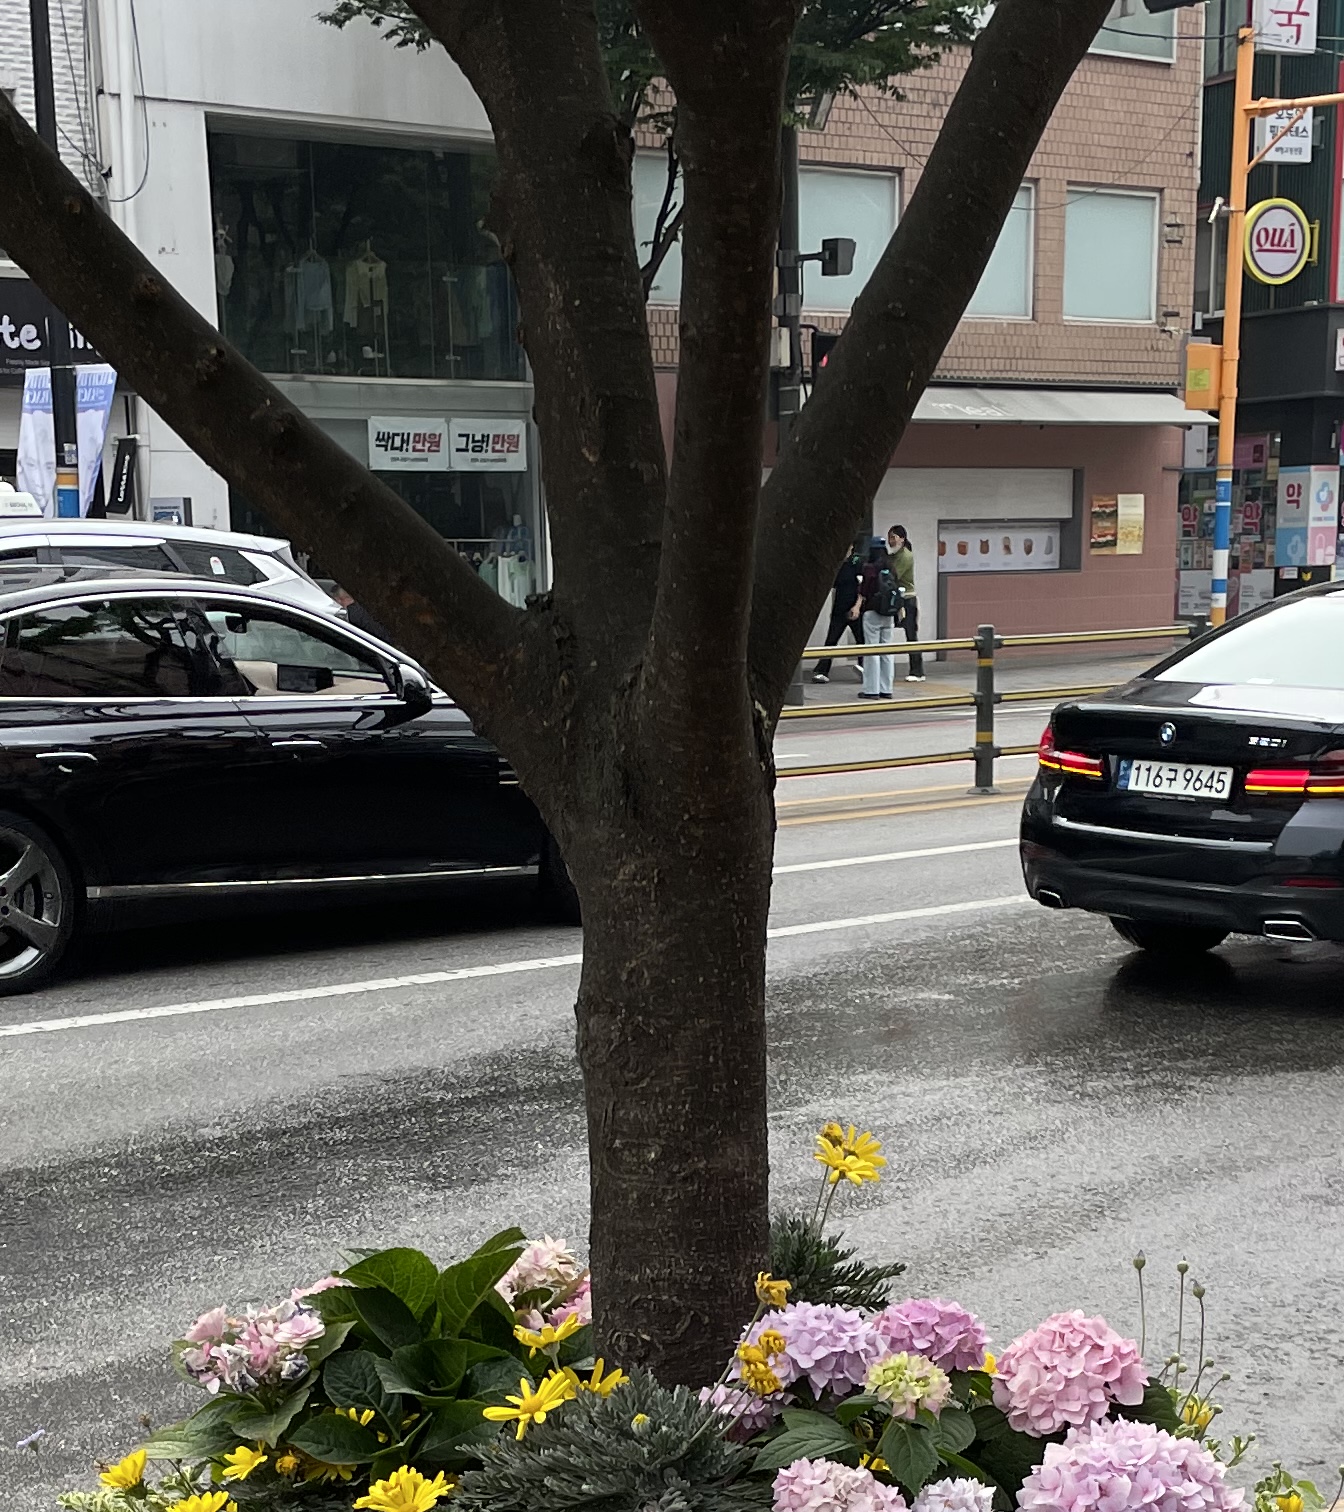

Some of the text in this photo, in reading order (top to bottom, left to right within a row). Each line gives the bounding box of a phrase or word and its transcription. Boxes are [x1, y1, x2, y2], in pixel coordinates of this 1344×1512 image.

[374, 431, 442, 453] 싹다! 만원
[455, 433, 521, 454] 그냥! 만원
[1286, 483, 1302, 510] 약
[1183, 768, 1227, 794] 9645
